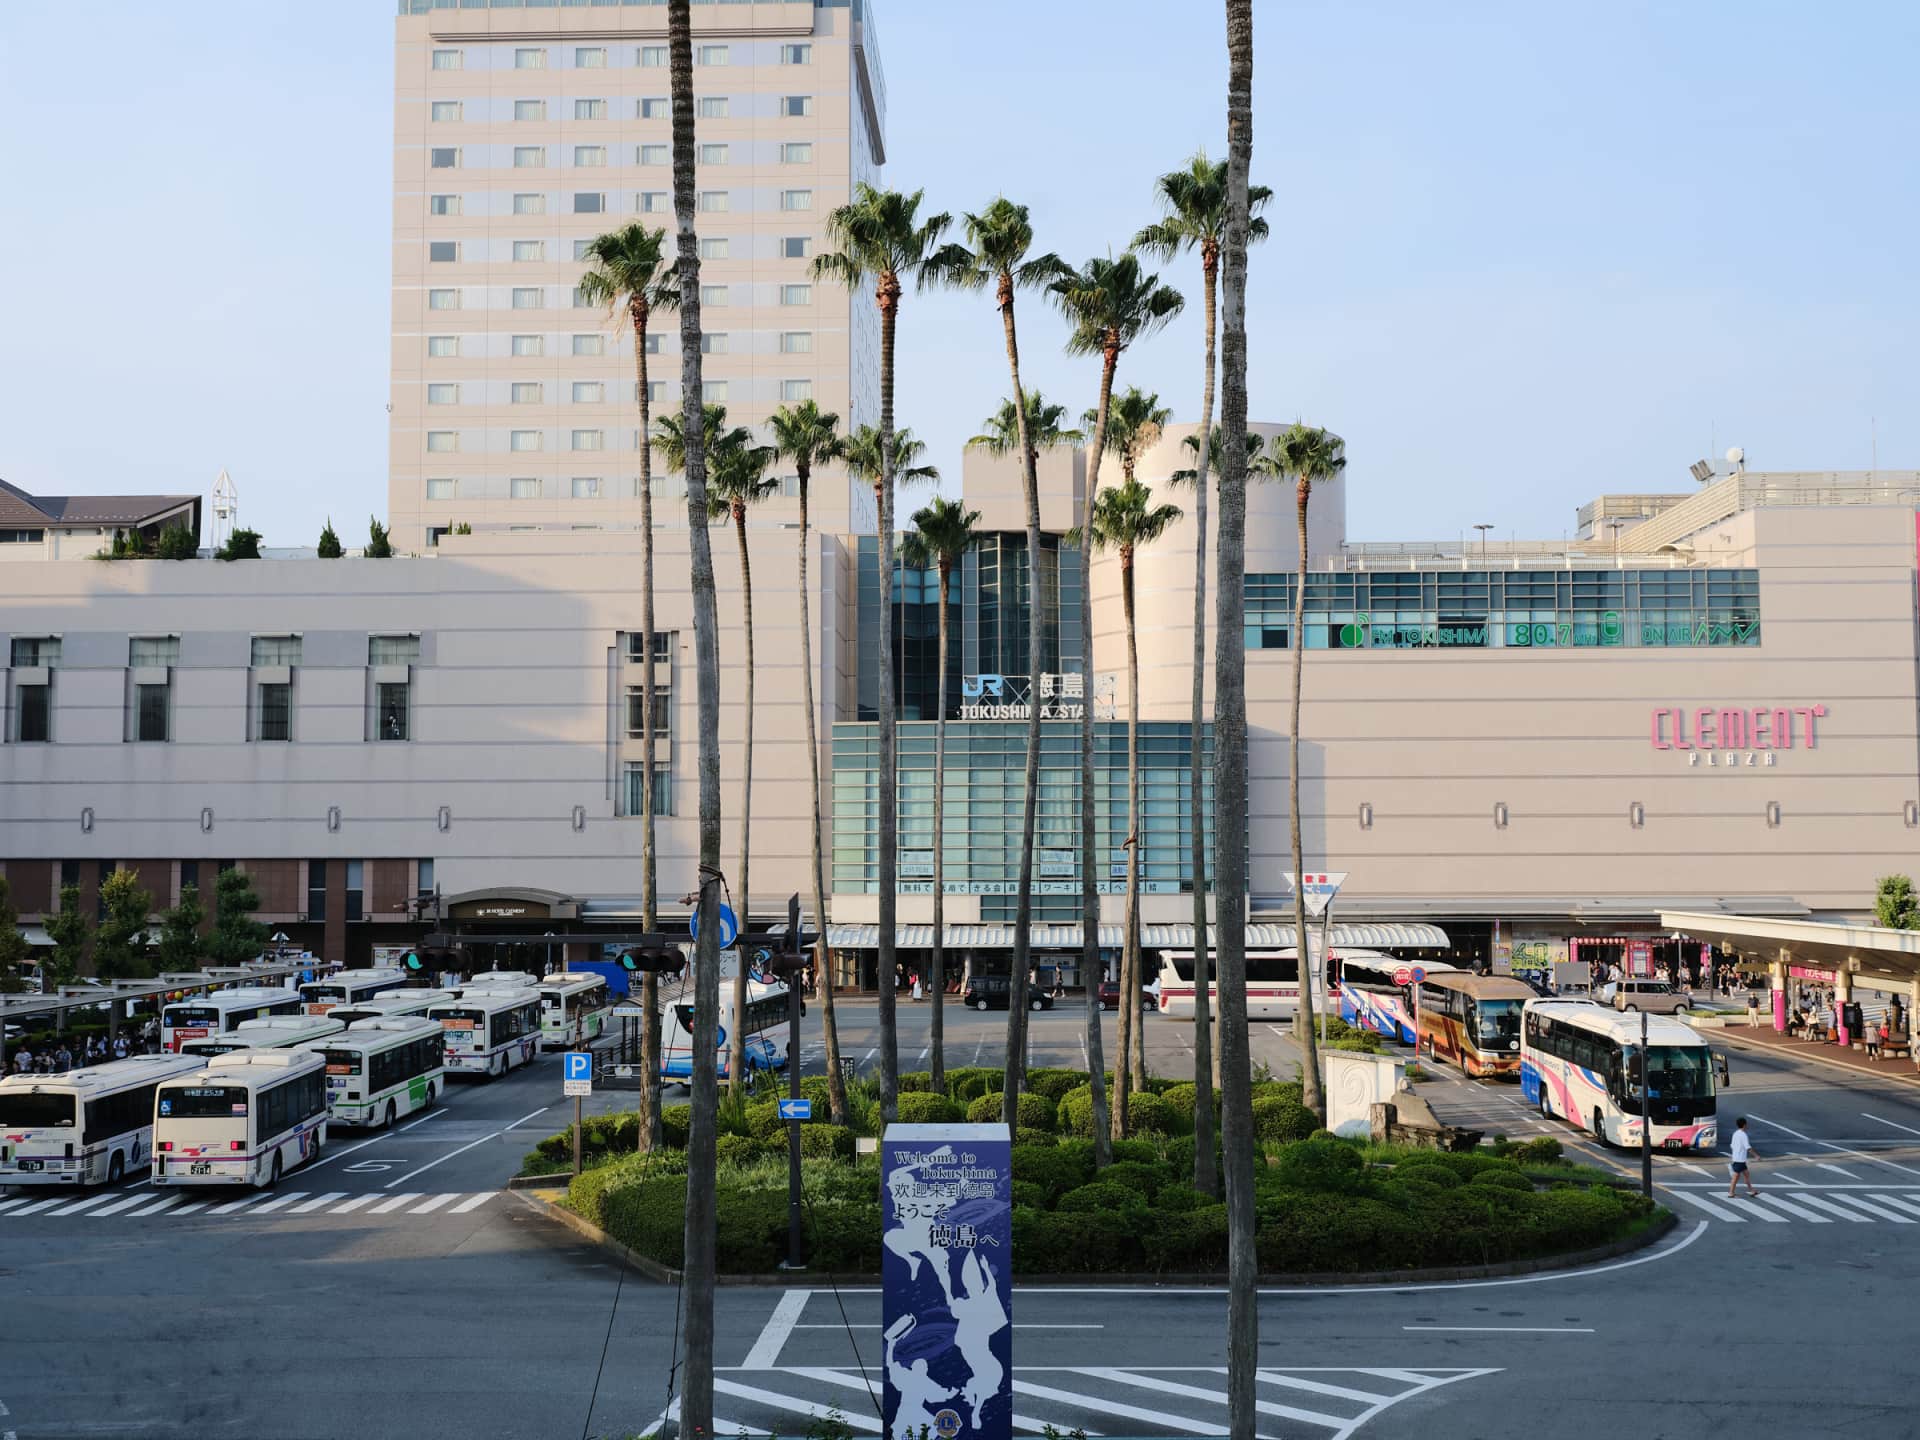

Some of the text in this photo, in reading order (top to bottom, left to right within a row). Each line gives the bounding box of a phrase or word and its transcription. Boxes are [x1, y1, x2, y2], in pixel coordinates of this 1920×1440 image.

[1515, 623, 1571, 645] 80.7
[962, 674, 1004, 697] JR
[1058, 704, 1117, 720] STAION
[1651, 707, 1815, 750] CLEMENT
[1688, 752, 1777, 767] PLAZA
[571, 1055, 587, 1078] P
[894, 1151, 977, 1165] Welcome to
[920, 1166, 998, 1180] Tokushima
[894, 1182, 995, 1199] 欢迎来到德岛
[894, 1203, 949, 1219] ようこそ
[928, 1224, 999, 1249] 徳島へ
